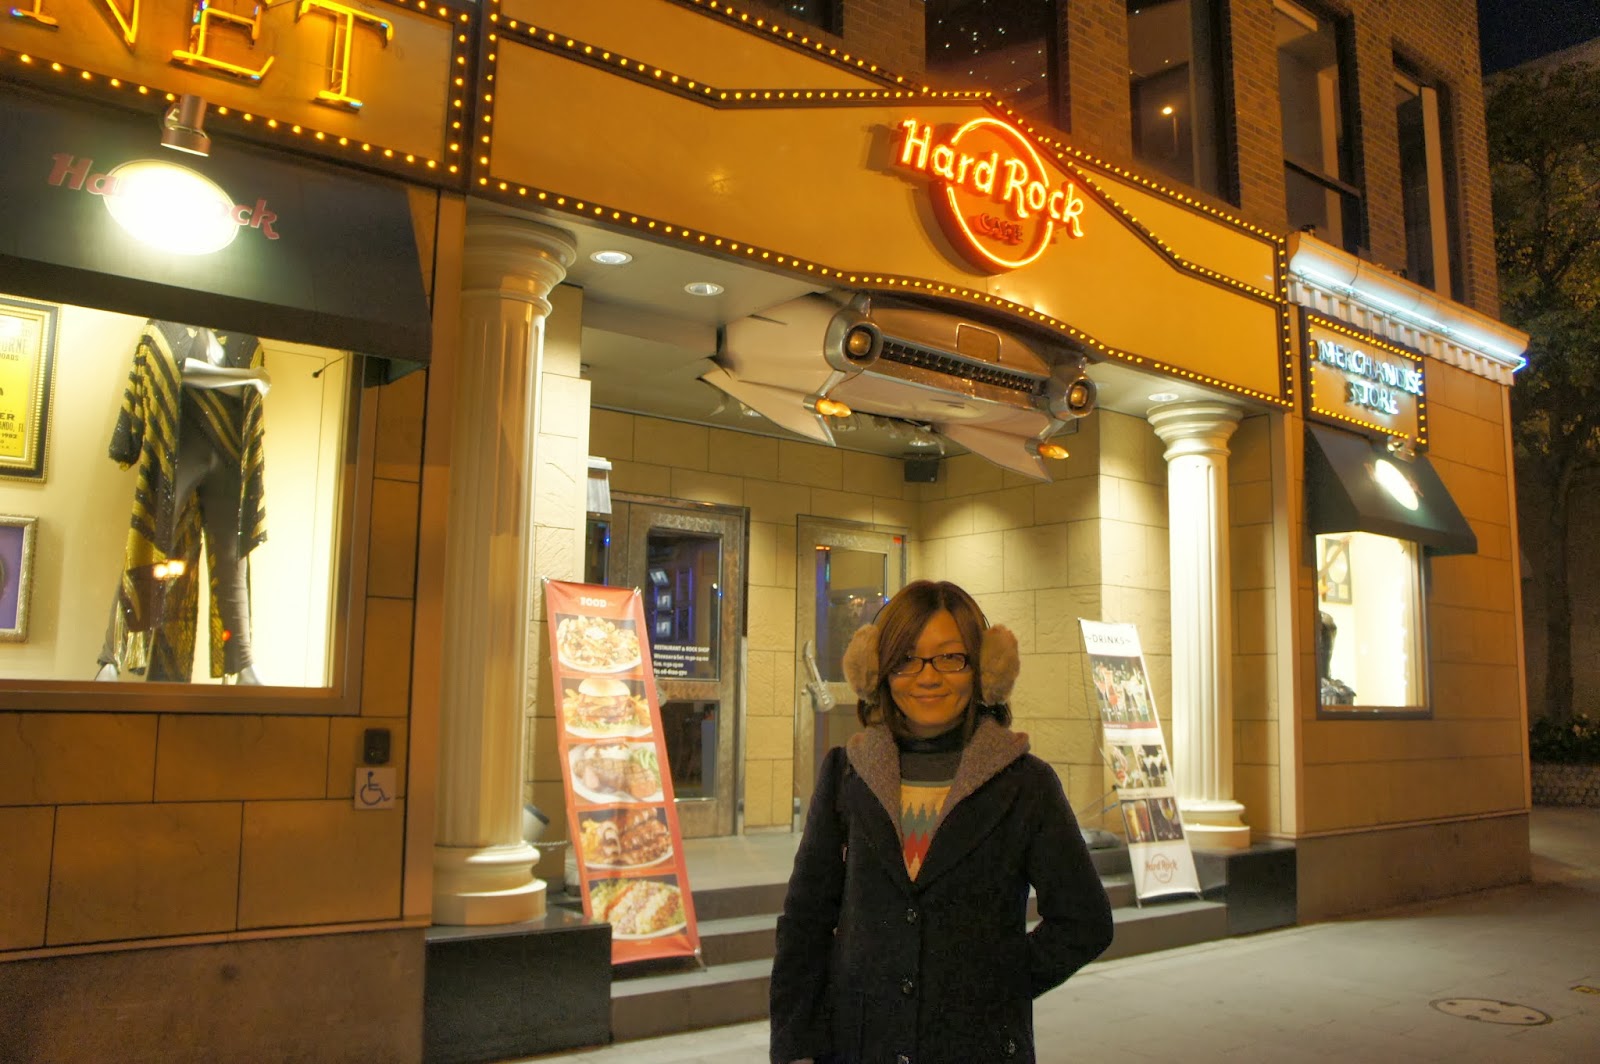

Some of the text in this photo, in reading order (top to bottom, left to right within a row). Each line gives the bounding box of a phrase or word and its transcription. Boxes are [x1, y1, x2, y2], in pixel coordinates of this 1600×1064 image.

[901, 118, 1085, 238] Hard Rock
[974, 213, 1023, 245] CAFE
[1319, 339, 1424, 396] MERCHANDISE
[1347, 379, 1399, 415] STORE
[580, 596, 607, 608] FOOD
